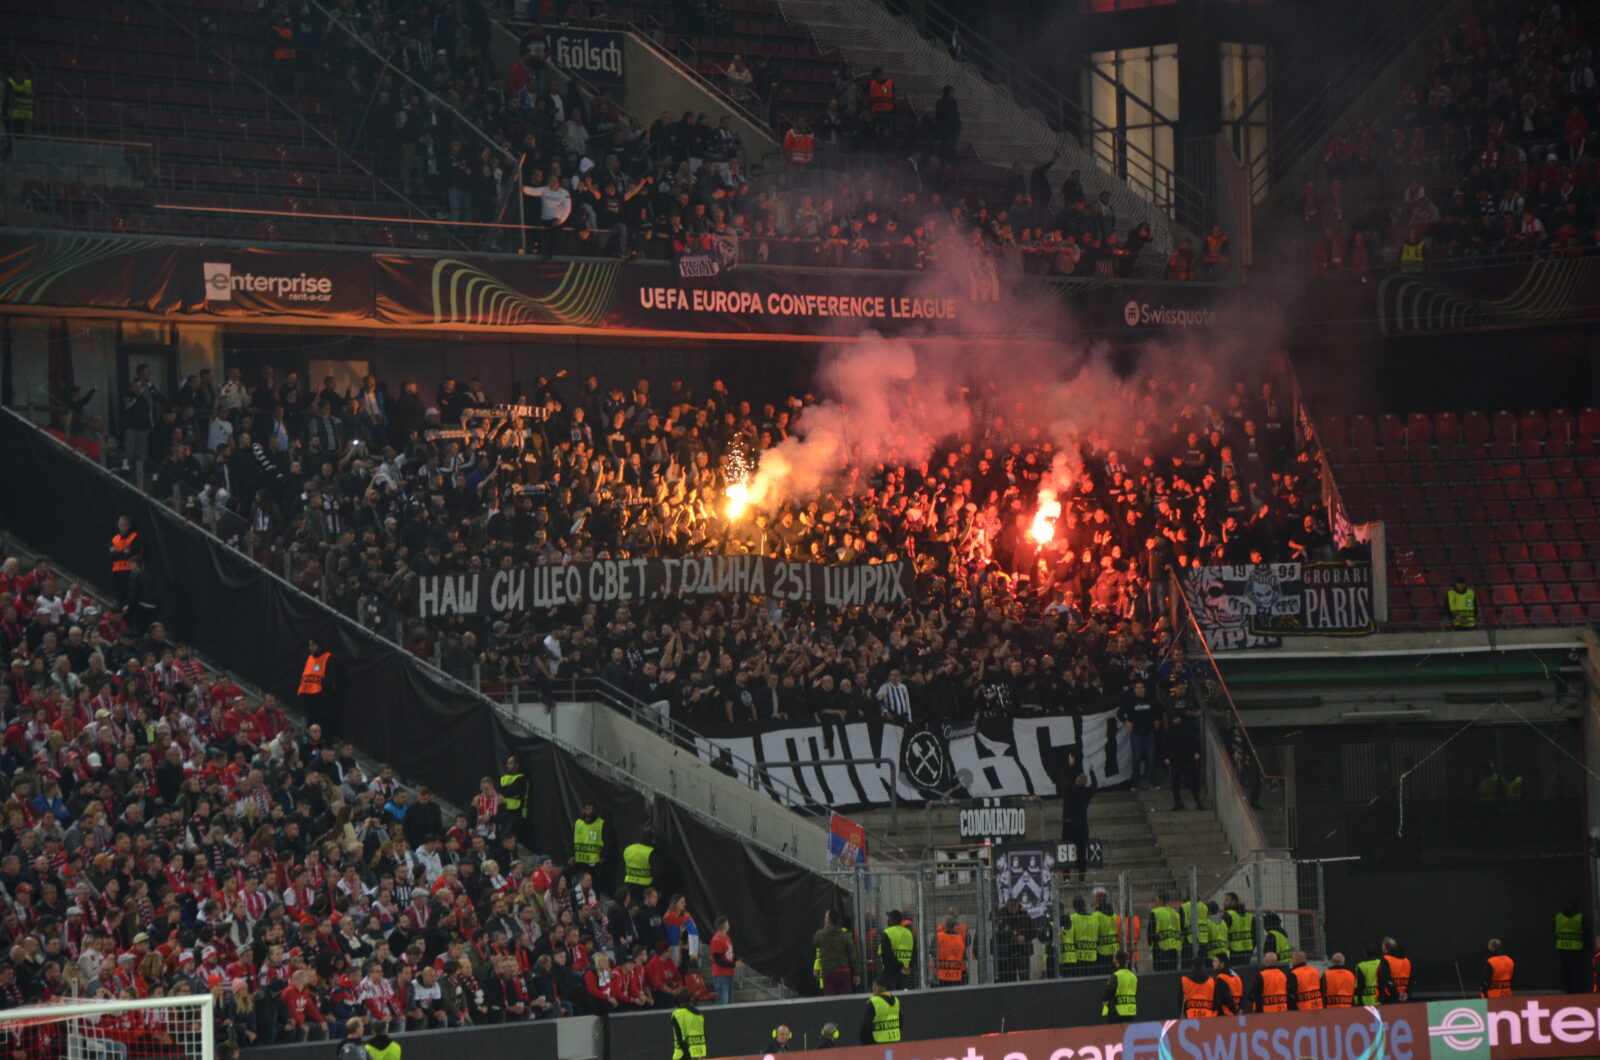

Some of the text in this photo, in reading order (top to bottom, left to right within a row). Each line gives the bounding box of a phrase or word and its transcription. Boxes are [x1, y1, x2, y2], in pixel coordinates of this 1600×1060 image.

[205, 272, 332, 298] enterprise
[640, 287, 958, 319] UEFA EUROPA CONFERENCE LEAGUE
[1141, 303, 1217, 329] Swissquote
[420, 574, 479, 618] НАШ
[491, 568, 525, 611] СИ
[534, 565, 582, 608] ЦЕО
[772, 561, 812, 601] 25!
[824, 561, 907, 609] ЦИРИХ
[1303, 587, 1370, 630] PARIS
[959, 807, 1026, 837] COMMANDO
[1428, 1000, 1600, 1051] ente
